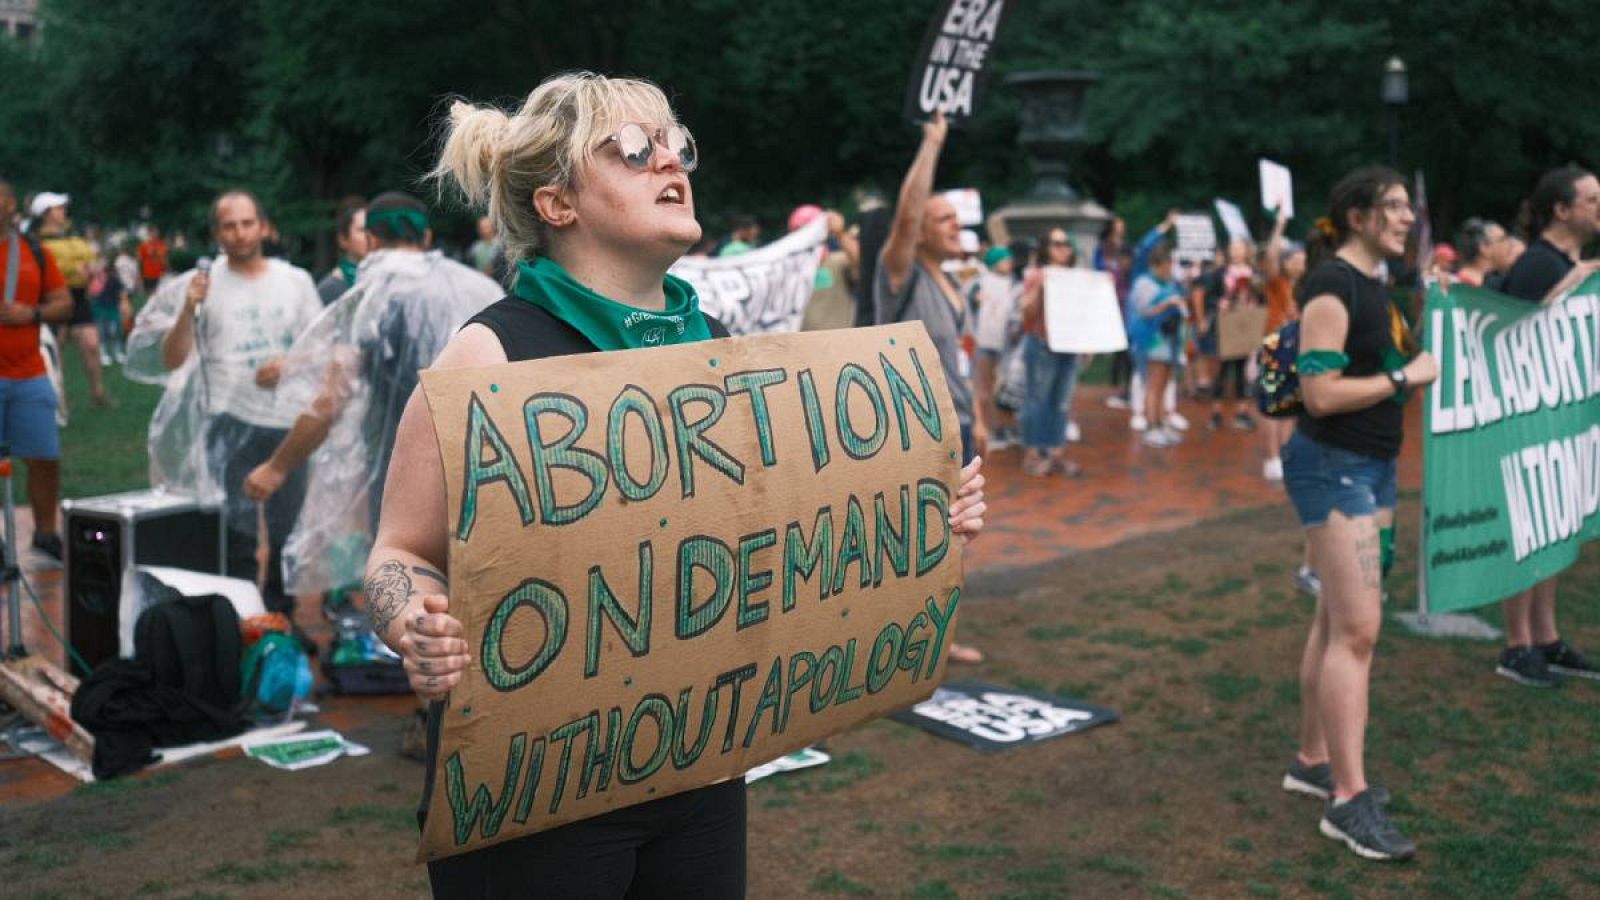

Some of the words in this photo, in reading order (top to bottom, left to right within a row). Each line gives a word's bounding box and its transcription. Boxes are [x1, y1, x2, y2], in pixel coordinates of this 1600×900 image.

[920, 64, 973, 116] USA
[457, 348, 942, 543] ABORTION
[481, 540, 653, 692] ON
[675, 477, 951, 640] DEMAND
[445, 663, 757, 846] WITHOUT
[743, 587, 961, 748] APOLOGY
